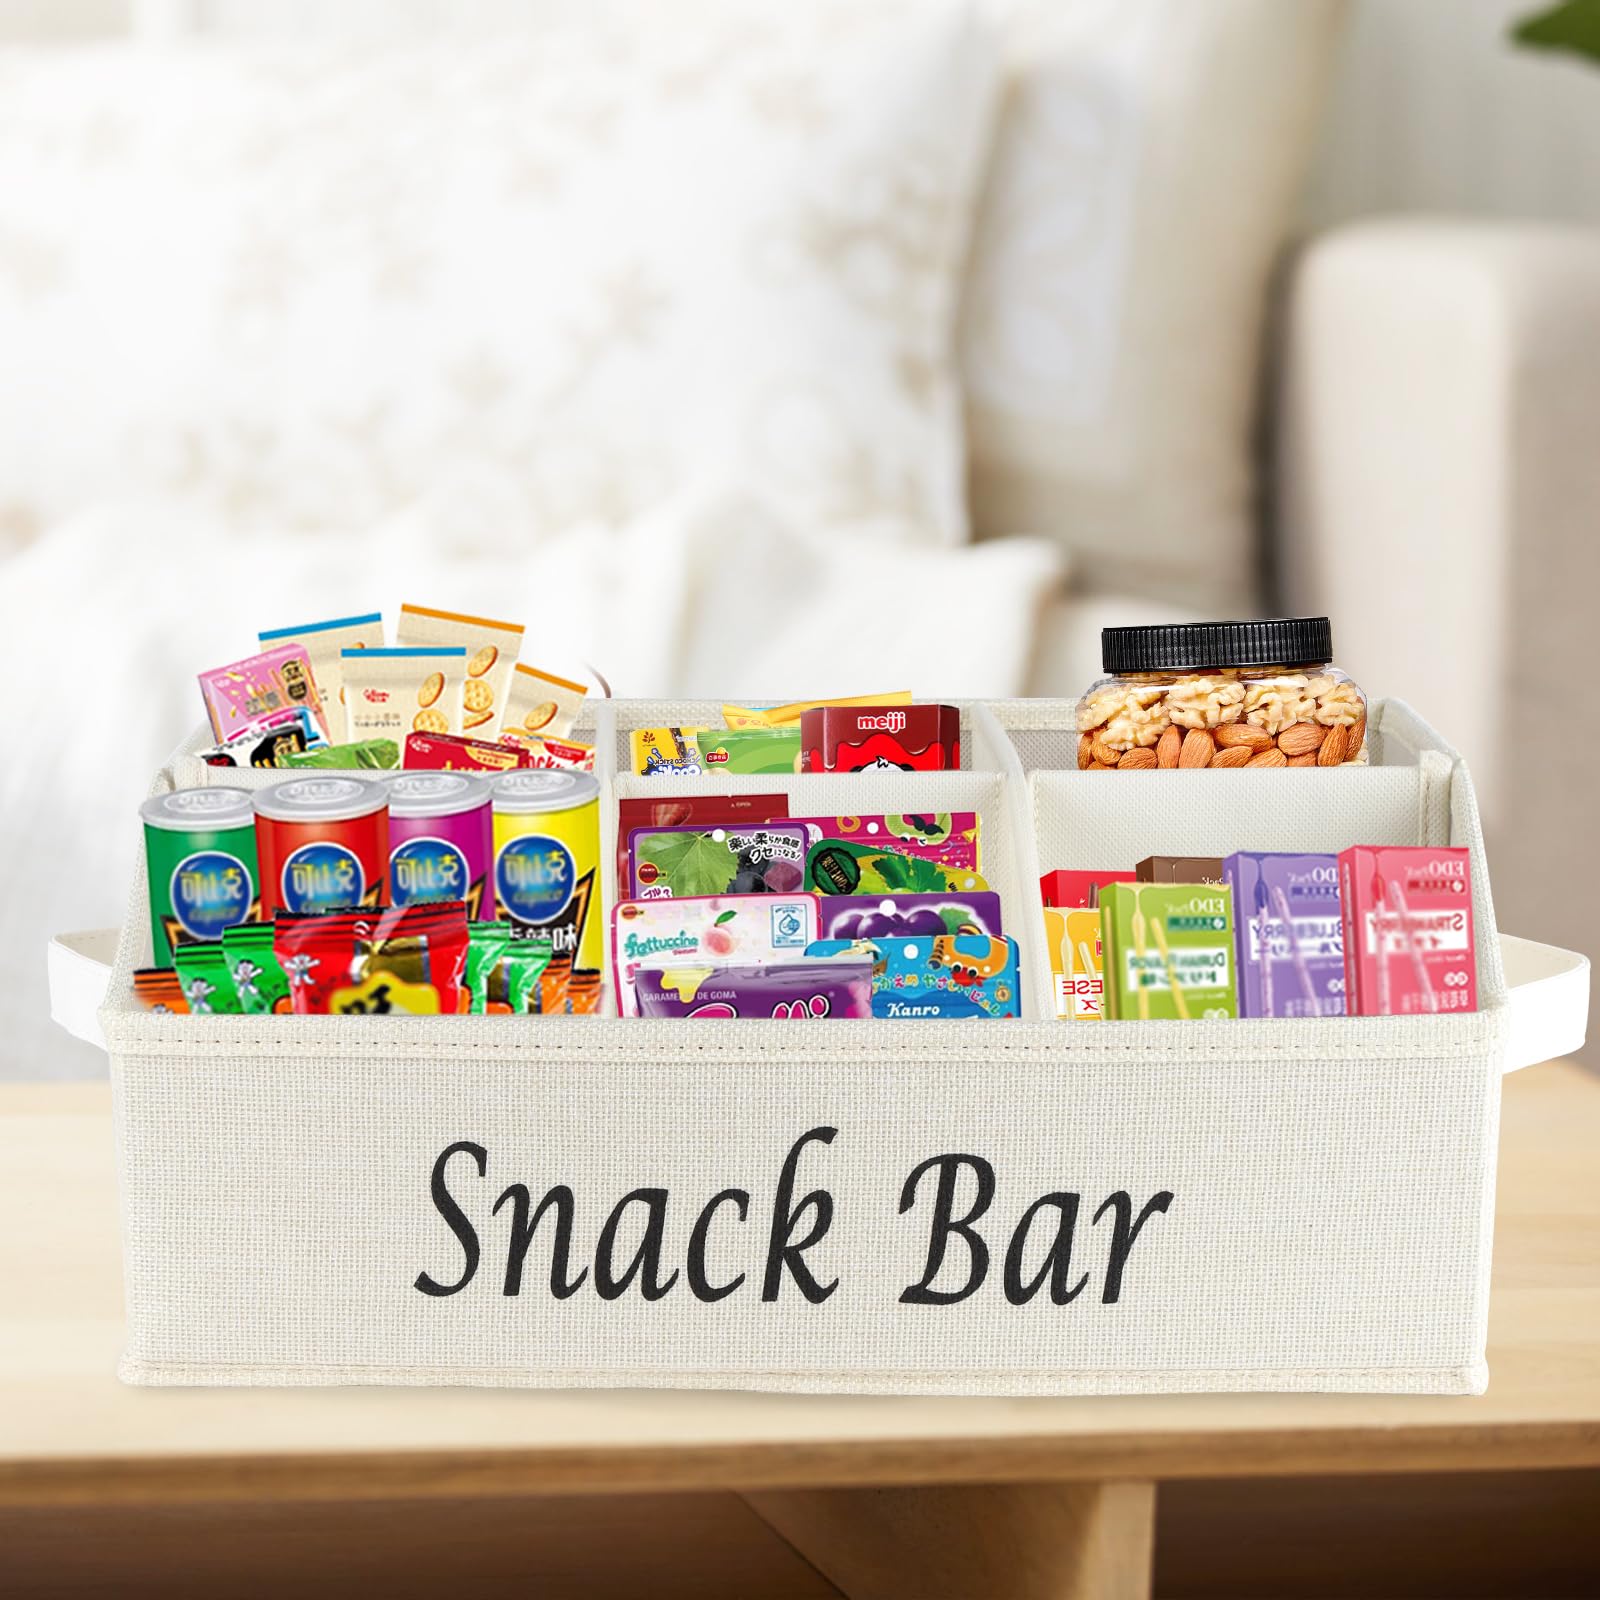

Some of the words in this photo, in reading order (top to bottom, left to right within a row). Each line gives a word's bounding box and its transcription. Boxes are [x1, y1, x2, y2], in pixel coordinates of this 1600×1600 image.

[858, 712, 906, 733] meiji
[697, 991, 709, 1000] DE
[710, 990, 737, 1000] GOMA
[887, 1003, 941, 1017] Kanro
[413, 1126, 839, 1303] Snack
[898, 1153, 1175, 1305] Bar
